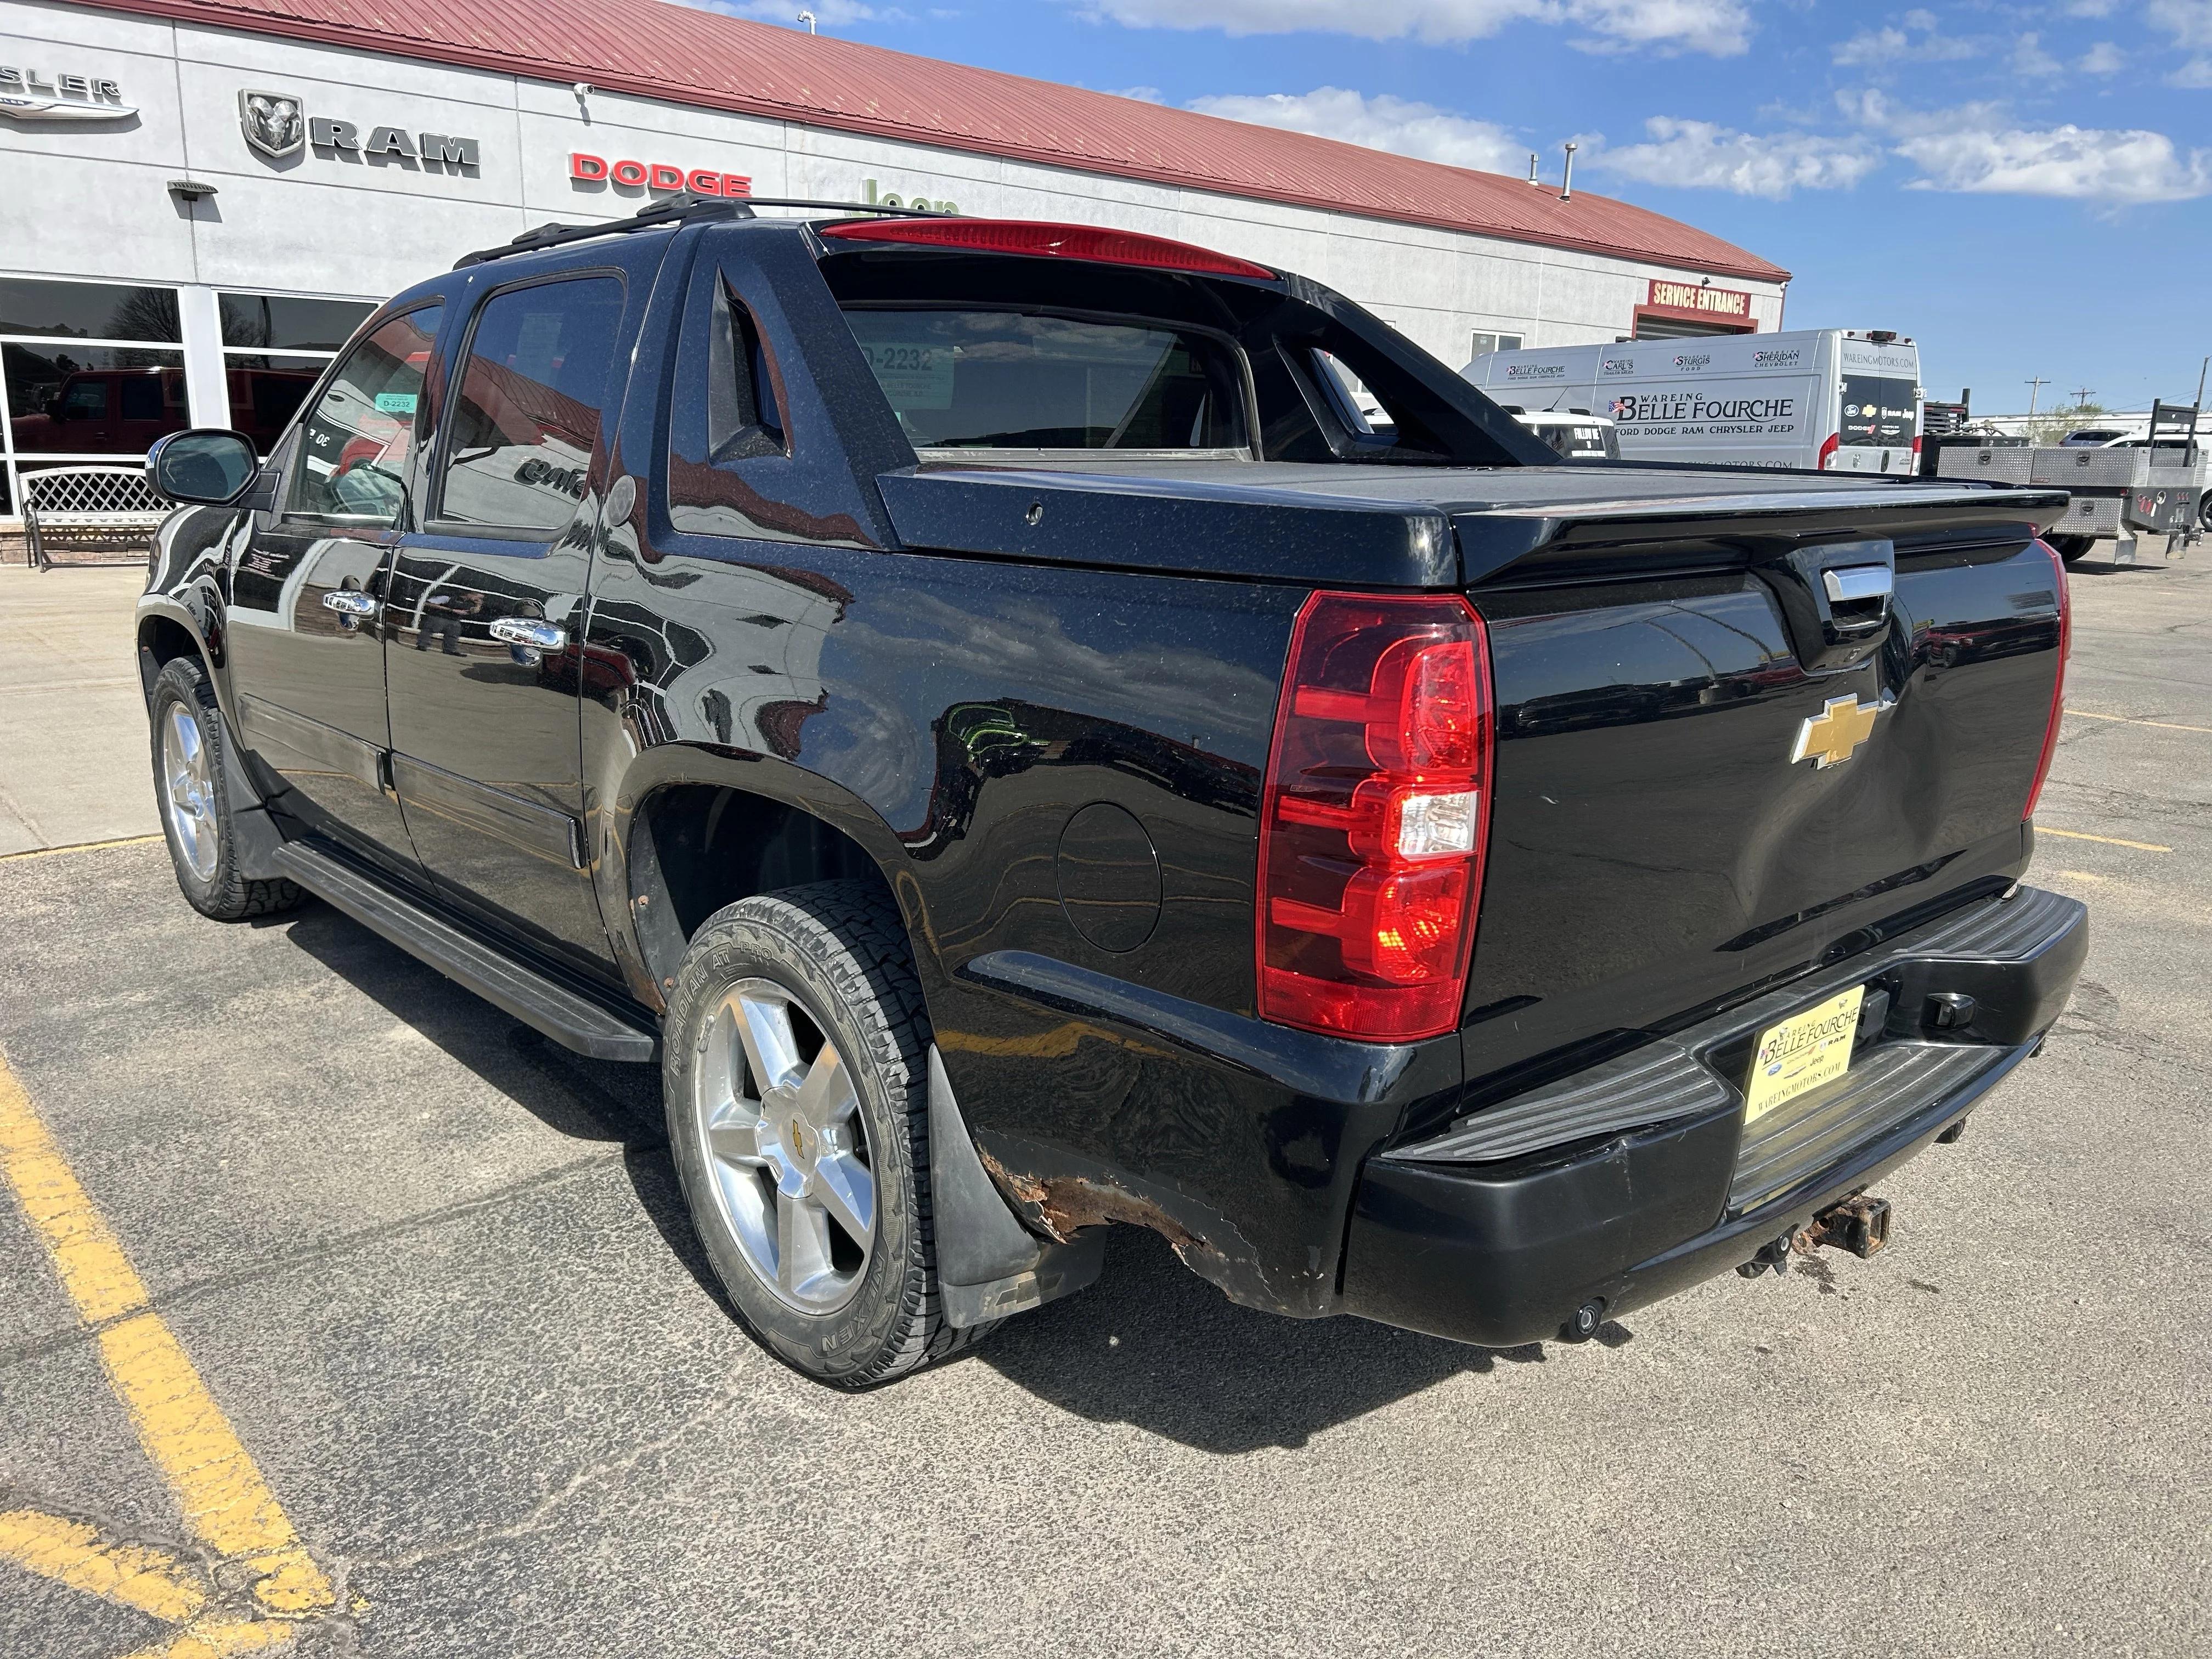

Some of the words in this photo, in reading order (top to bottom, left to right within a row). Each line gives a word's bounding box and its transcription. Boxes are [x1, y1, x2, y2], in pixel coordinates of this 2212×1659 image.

[309, 117, 481, 165] RAM
[569, 153, 752, 198] DODGE
[1654, 282, 1696, 309] SERVICE
[1697, 289, 1746, 315] ENTRANCE
[1676, 356, 1710, 366] STURGIS
[1756, 352, 1799, 362] SHERIDAN
[1843, 352, 1914, 369] WAREINGMOTORS.COM
[1509, 366, 1532, 375] BELLE
[1533, 366, 1565, 374] FOURCHE
[1606, 360, 1633, 370] CARL'S
[1640, 393, 1703, 403] WAREING
[1617, 396, 1687, 421] BELLE
[1692, 399, 1793, 422] FOURCHE
[1644, 427, 1677, 435] DODGE
[1681, 426, 1704, 435] RAM
[1709, 425, 1763, 434] CHRYSLER
[1768, 425, 1794, 433] JEEP
[670, 963, 709, 1079] ROADIAN
[712, 947, 730, 970] AT
[740, 941, 774, 960] PRO
[1763, 1033, 1805, 1066] BELLE
[1806, 1006, 1859, 1044] FOURCHE
[1828, 1035, 1847, 1046] RAM
[1810, 1055, 1825, 1066] Jeep
[821, 1251, 885, 1353] NEXEN
